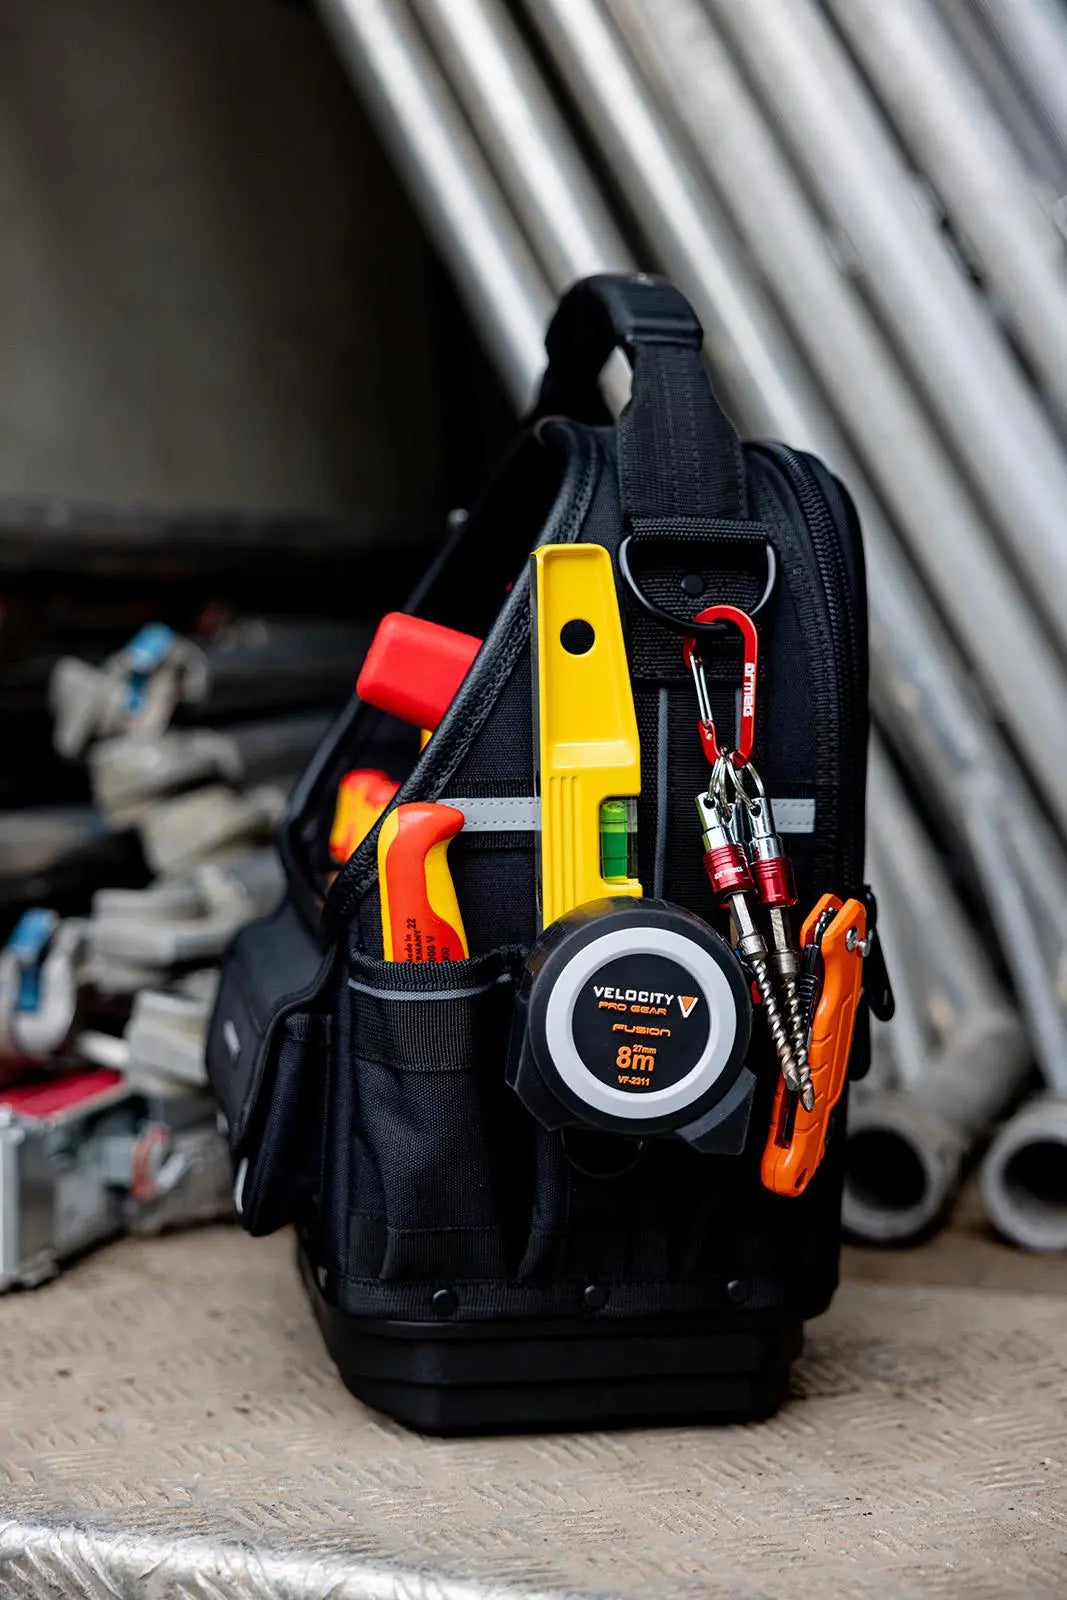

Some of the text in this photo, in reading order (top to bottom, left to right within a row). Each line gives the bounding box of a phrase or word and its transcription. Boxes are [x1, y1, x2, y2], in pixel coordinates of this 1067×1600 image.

[406, 918, 416, 929] 22
[414, 930, 422, 961] RMANY
[593, 985, 674, 1005] VELOCITY
[598, 1000, 667, 1016] PRO GEAR
[612, 1023, 671, 1037] FUSION
[632, 1044, 657, 1055] 27mm
[616, 1046, 655, 1072] 8m
[618, 1075, 650, 1086] VF-2311
